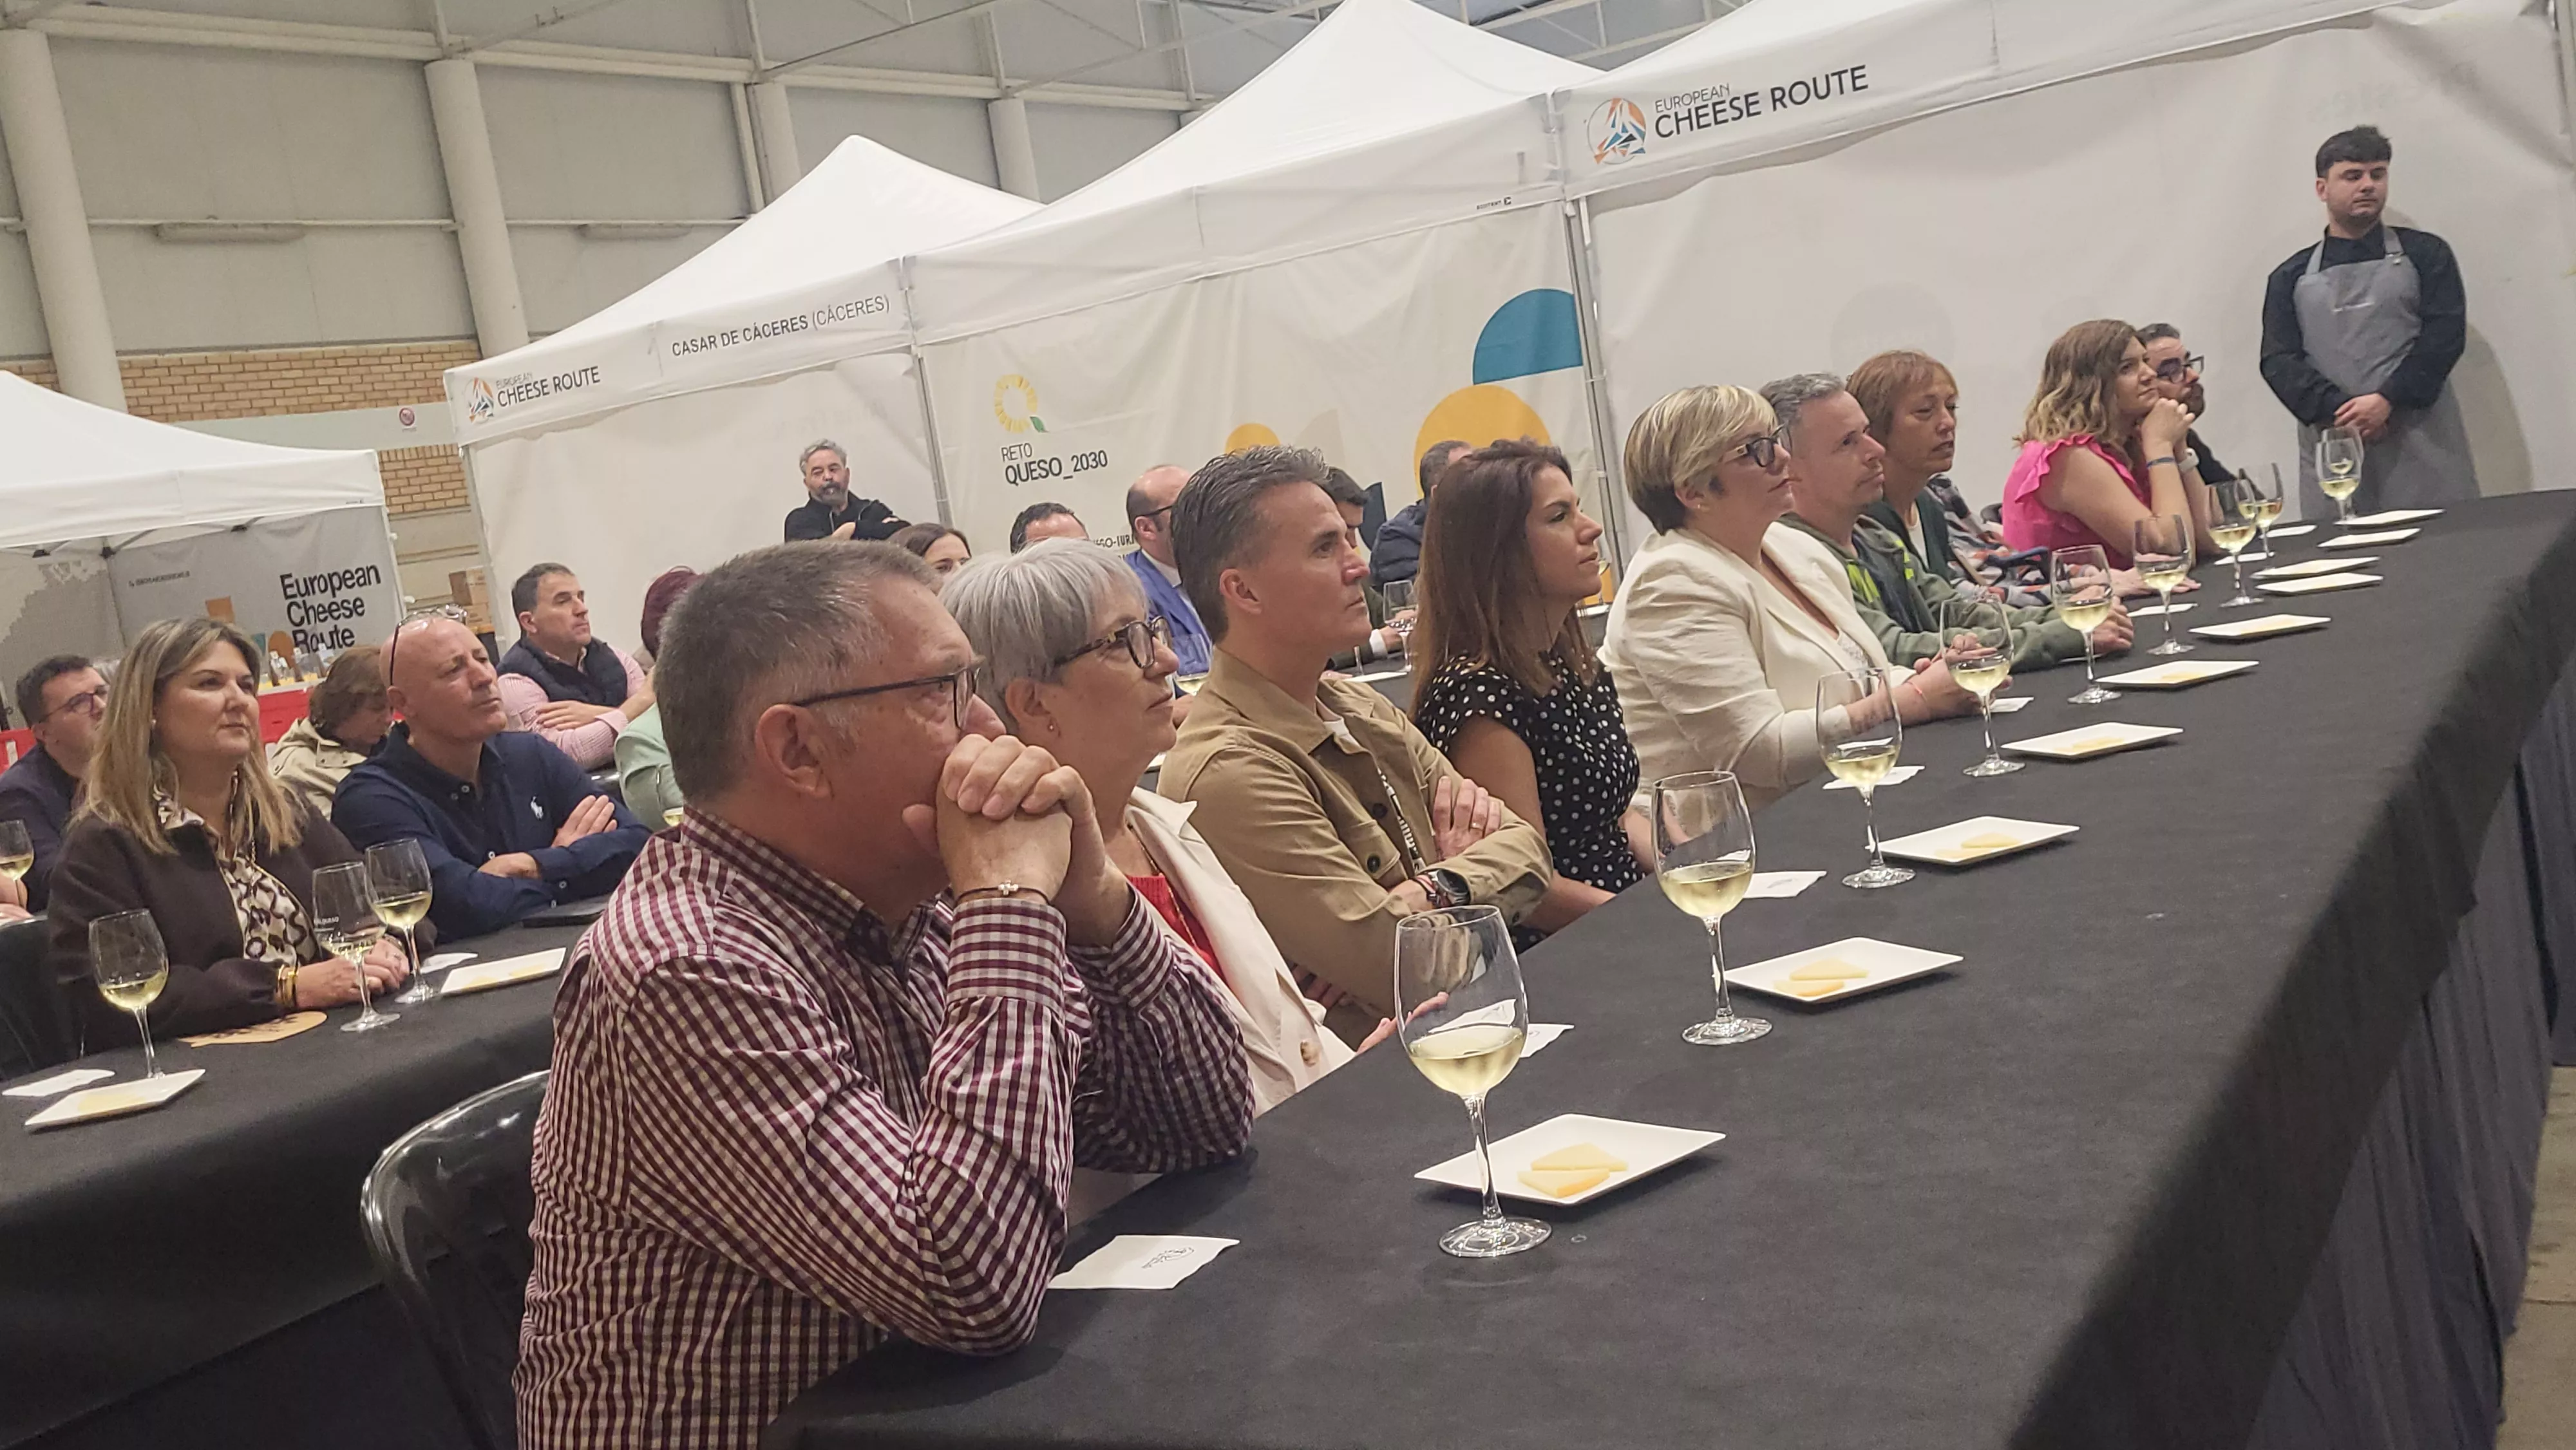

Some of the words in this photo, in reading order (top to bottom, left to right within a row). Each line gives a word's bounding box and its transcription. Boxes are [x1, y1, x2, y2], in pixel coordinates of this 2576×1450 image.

[1654, 91, 1762, 138] CHEESE
[1770, 64, 1869, 112] ROUTE
[1655, 83, 1730, 113] EUROPEAN
[672, 334, 718, 356] CASAR
[720, 330, 740, 347] DE
[743, 314, 809, 341] CÁCERES
[813, 294, 890, 330] (CÁCERES)
[495, 372, 533, 390] EUROPEAN
[497, 379, 550, 407] CHEESE
[553, 365, 601, 393] ROUTE
[1001, 442, 1033, 463] RETO
[1005, 449, 1108, 486] QUESO_2030
[279, 564, 381, 600] European
[286, 596, 366, 627] Cheese
[292, 624, 355, 654] Route
